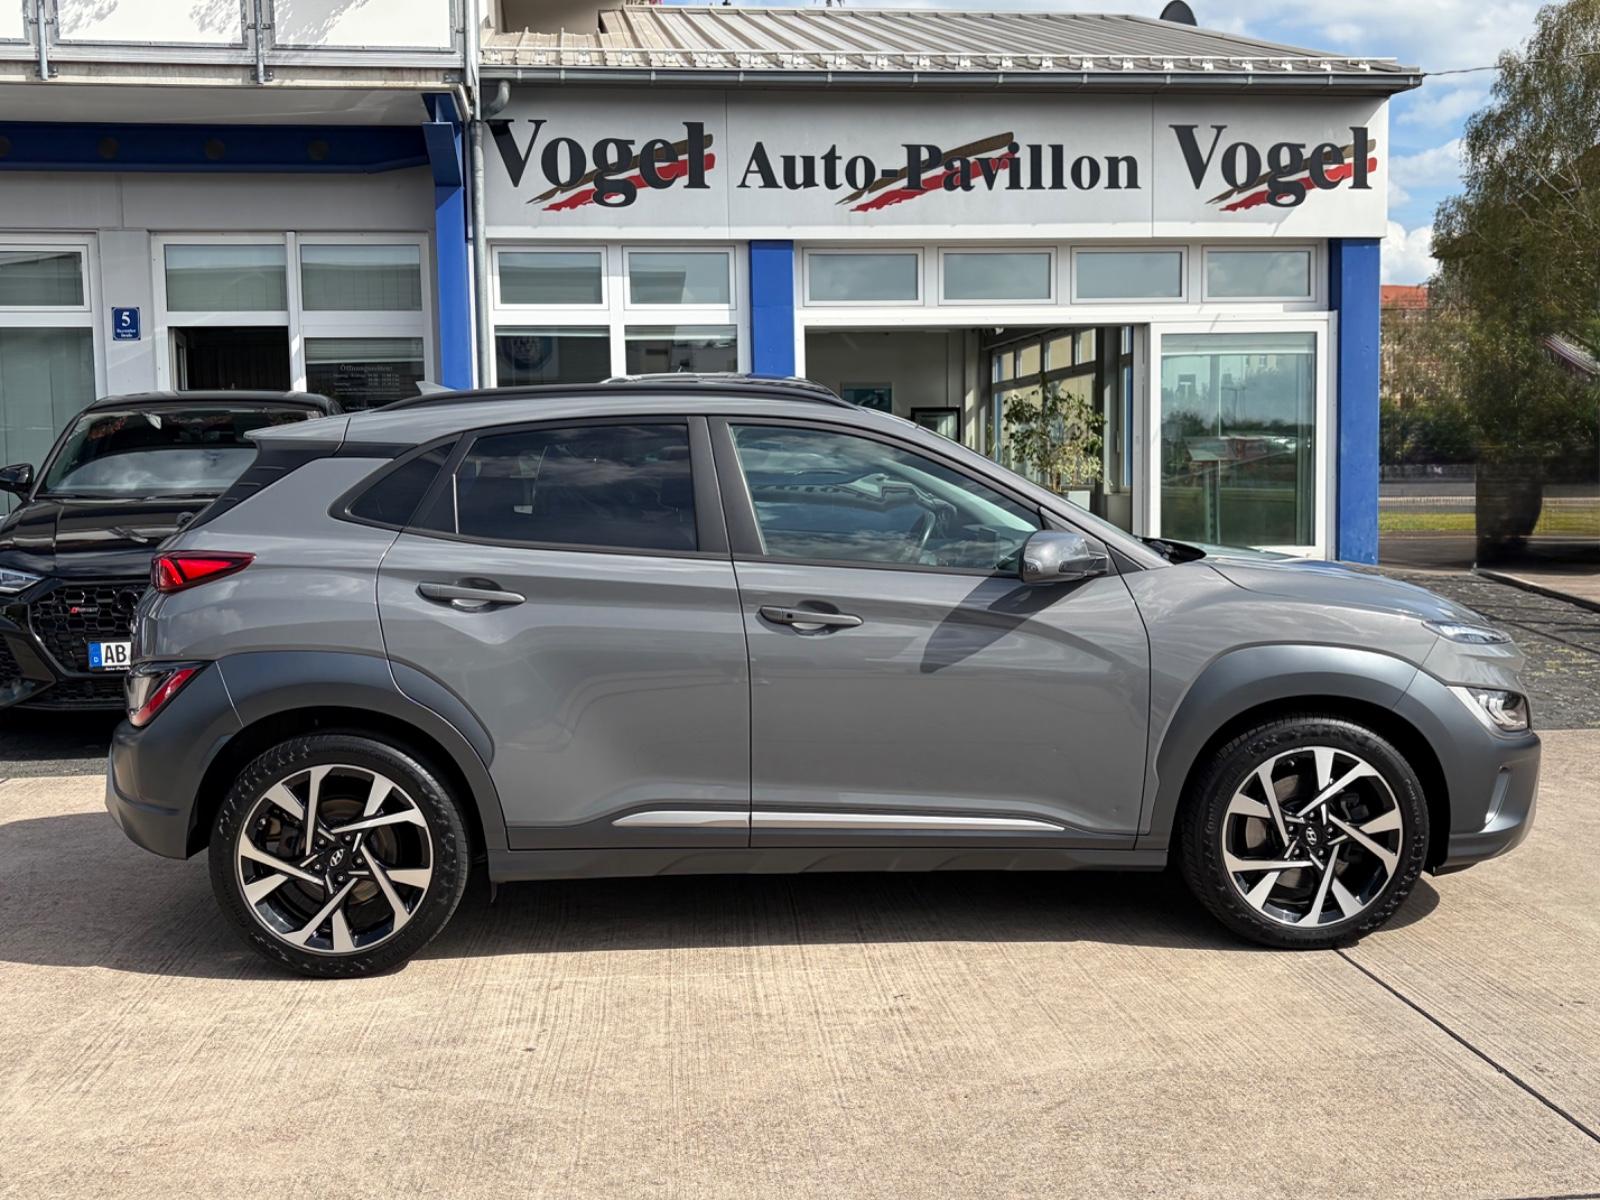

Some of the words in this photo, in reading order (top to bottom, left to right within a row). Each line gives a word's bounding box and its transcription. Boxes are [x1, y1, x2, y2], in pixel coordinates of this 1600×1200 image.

[485, 118, 711, 208] Vogel
[736, 140, 1142, 192] Auto-Pavillon
[1168, 124, 1373, 208] Vogel
[121, 311, 131, 327] 5
[104, 644, 127, 663] AB
